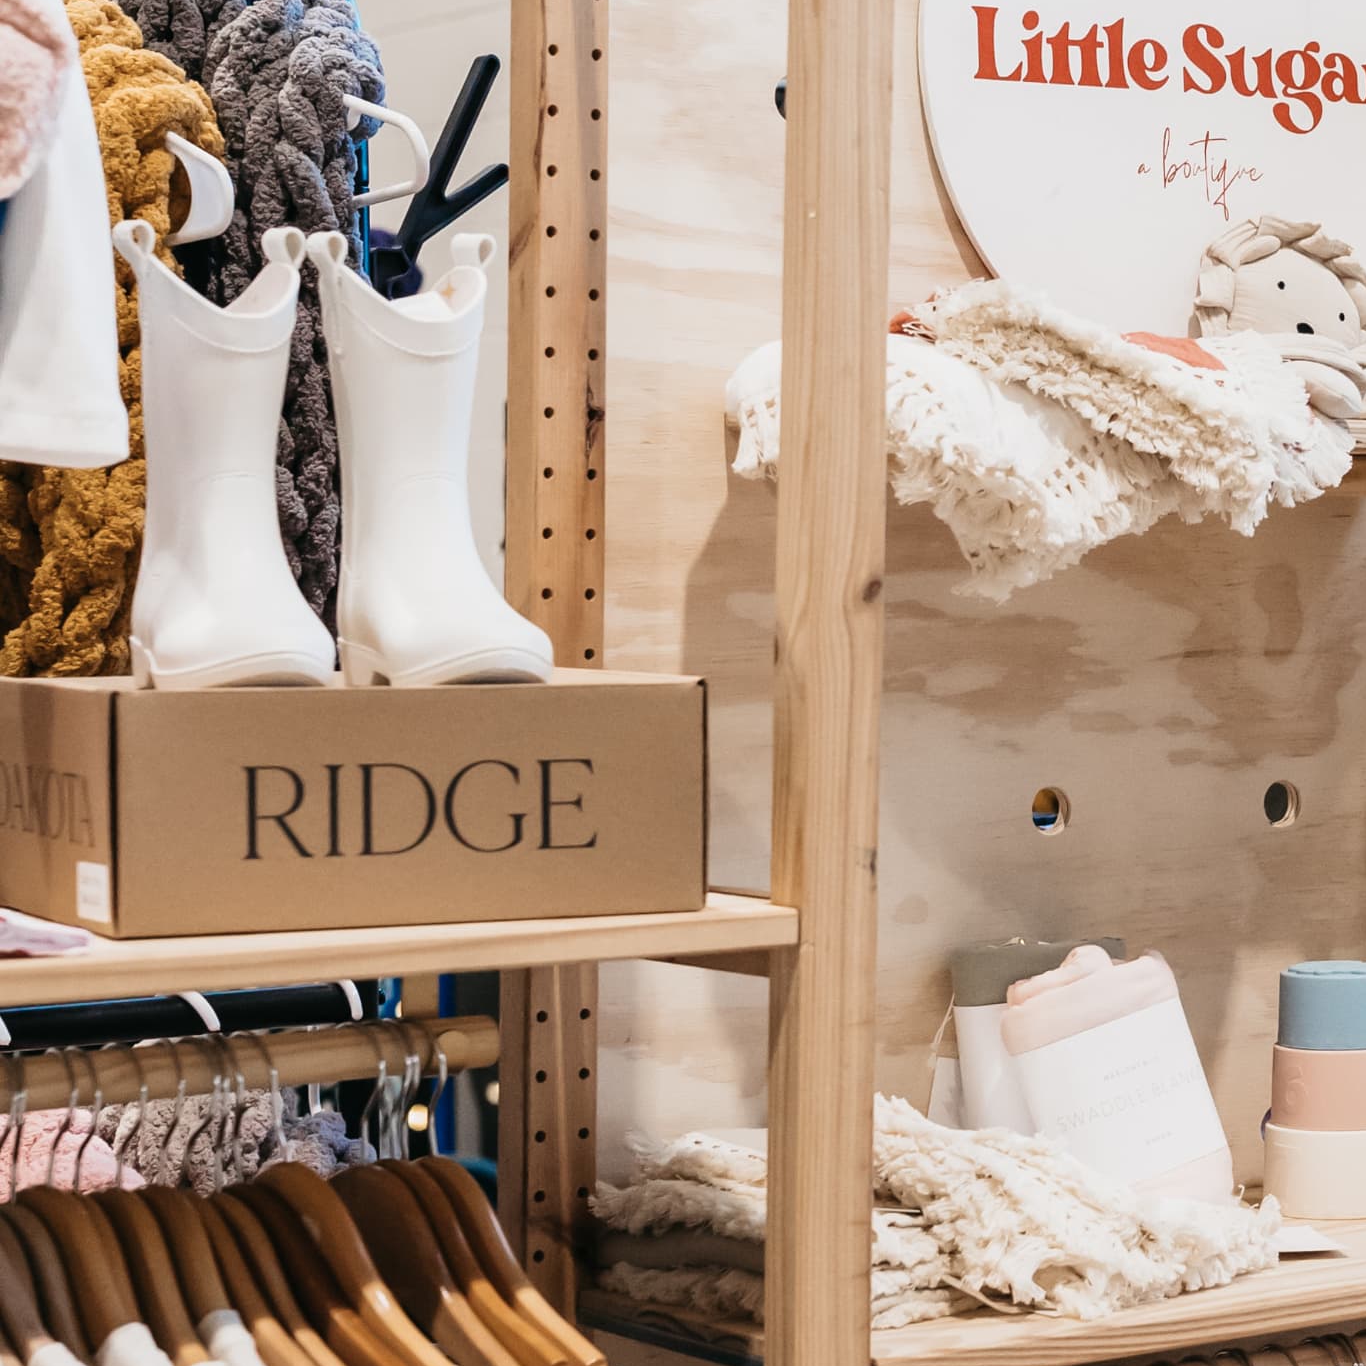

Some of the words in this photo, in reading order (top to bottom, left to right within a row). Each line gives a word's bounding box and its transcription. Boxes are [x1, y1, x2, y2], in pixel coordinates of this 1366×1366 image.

[971, 5, 1170, 91] Little
[1137, 163, 1151, 175] a
[1162, 126, 1264, 222] boutique
[242, 758, 598, 860] RIDGE
